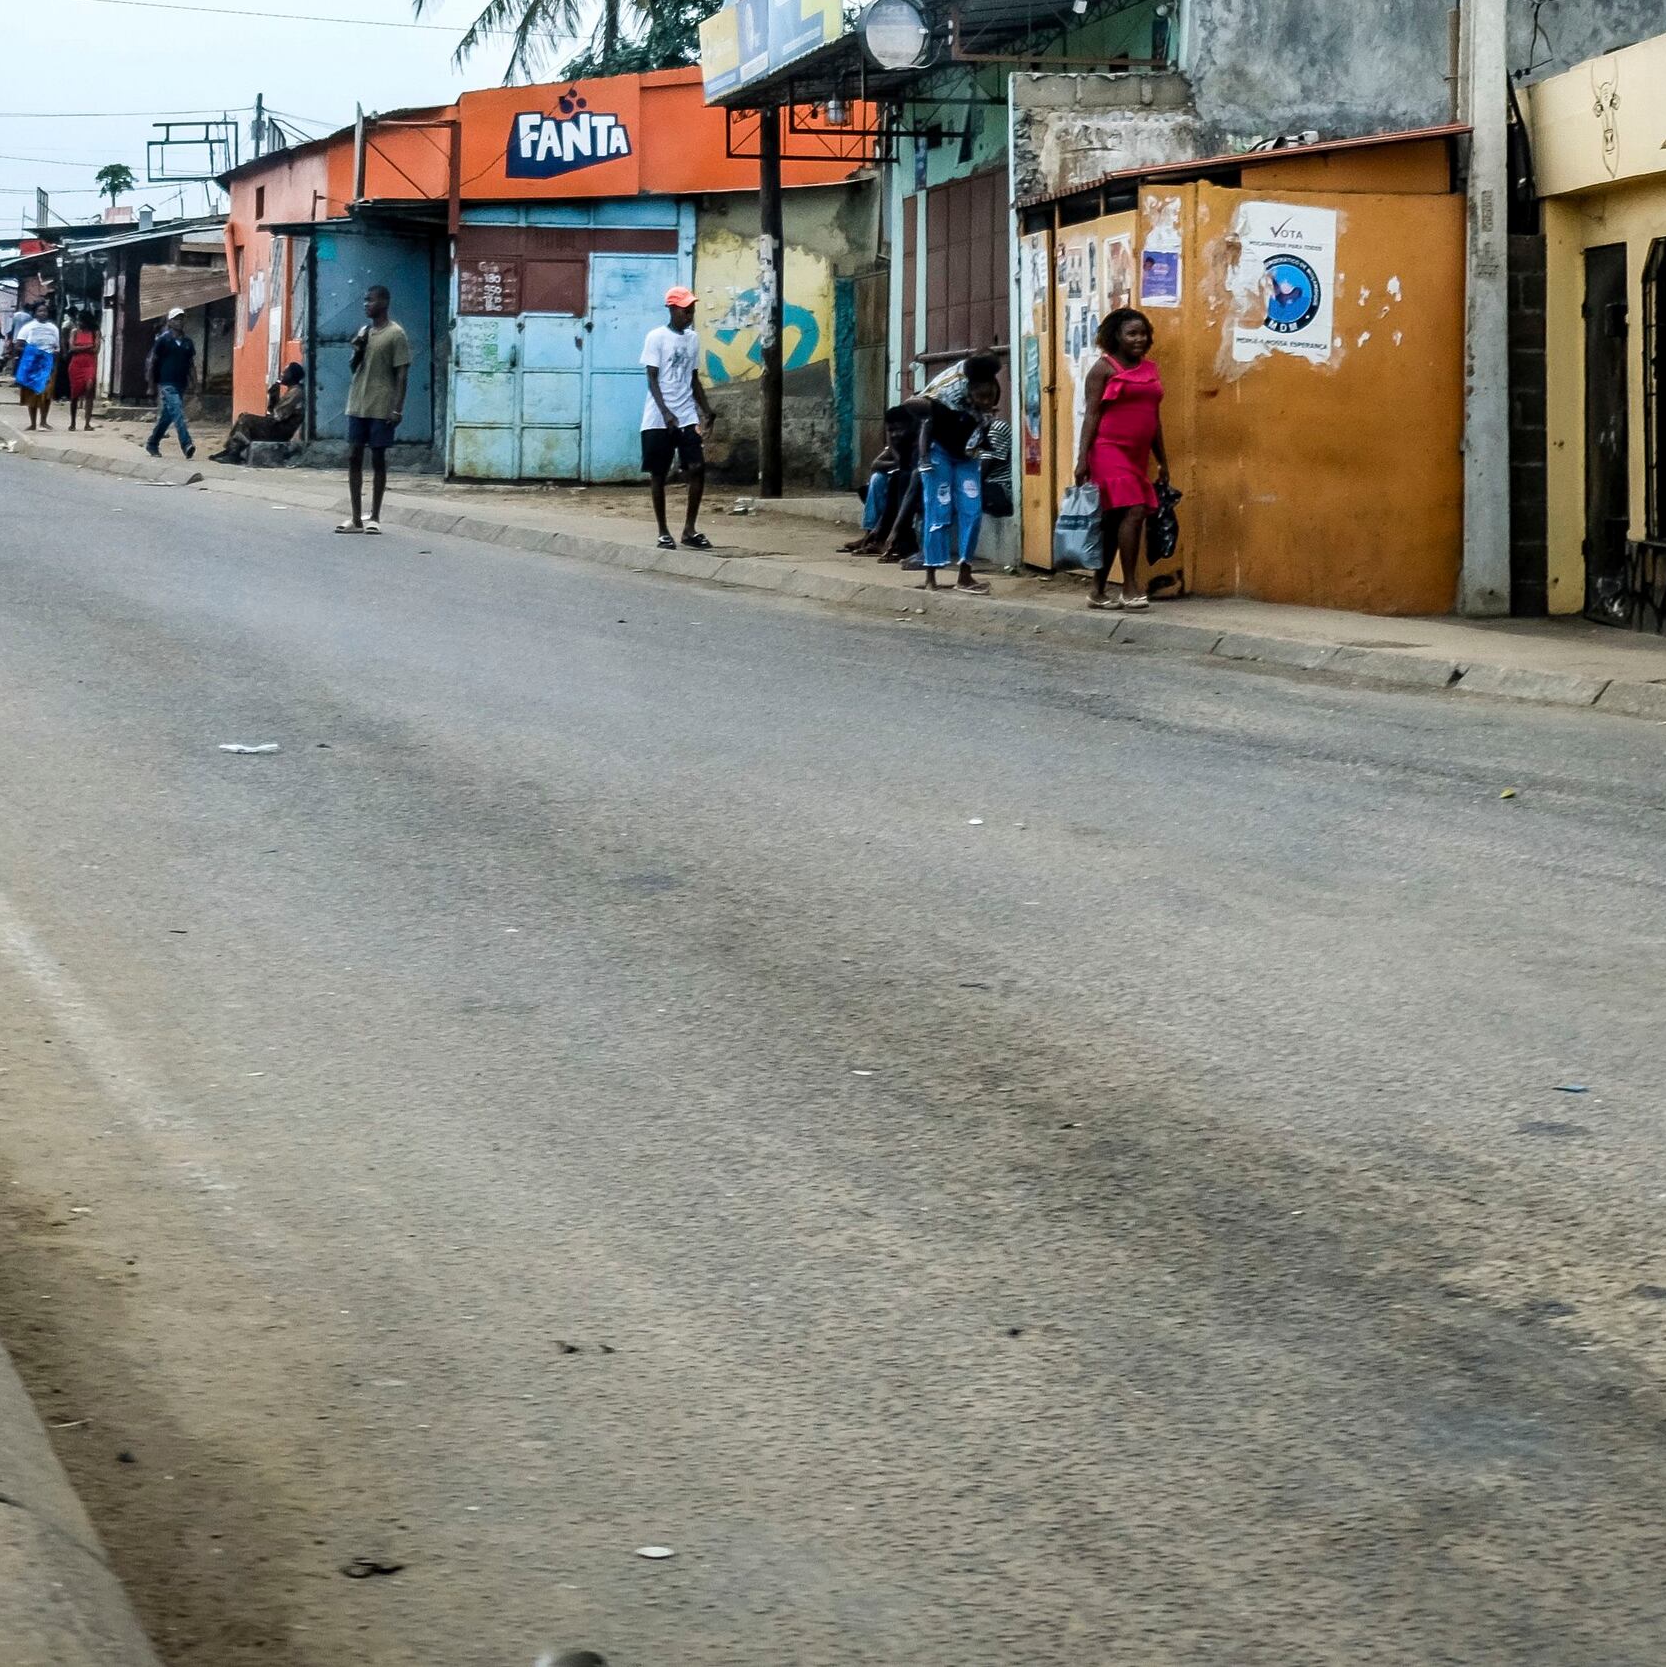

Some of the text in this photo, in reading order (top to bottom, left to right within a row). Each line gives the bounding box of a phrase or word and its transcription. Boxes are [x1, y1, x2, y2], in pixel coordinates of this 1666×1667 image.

[518, 114, 628, 162] FANTA
[1270, 217, 1303, 239] VOTA
[1268, 319, 1298, 332] MDM
